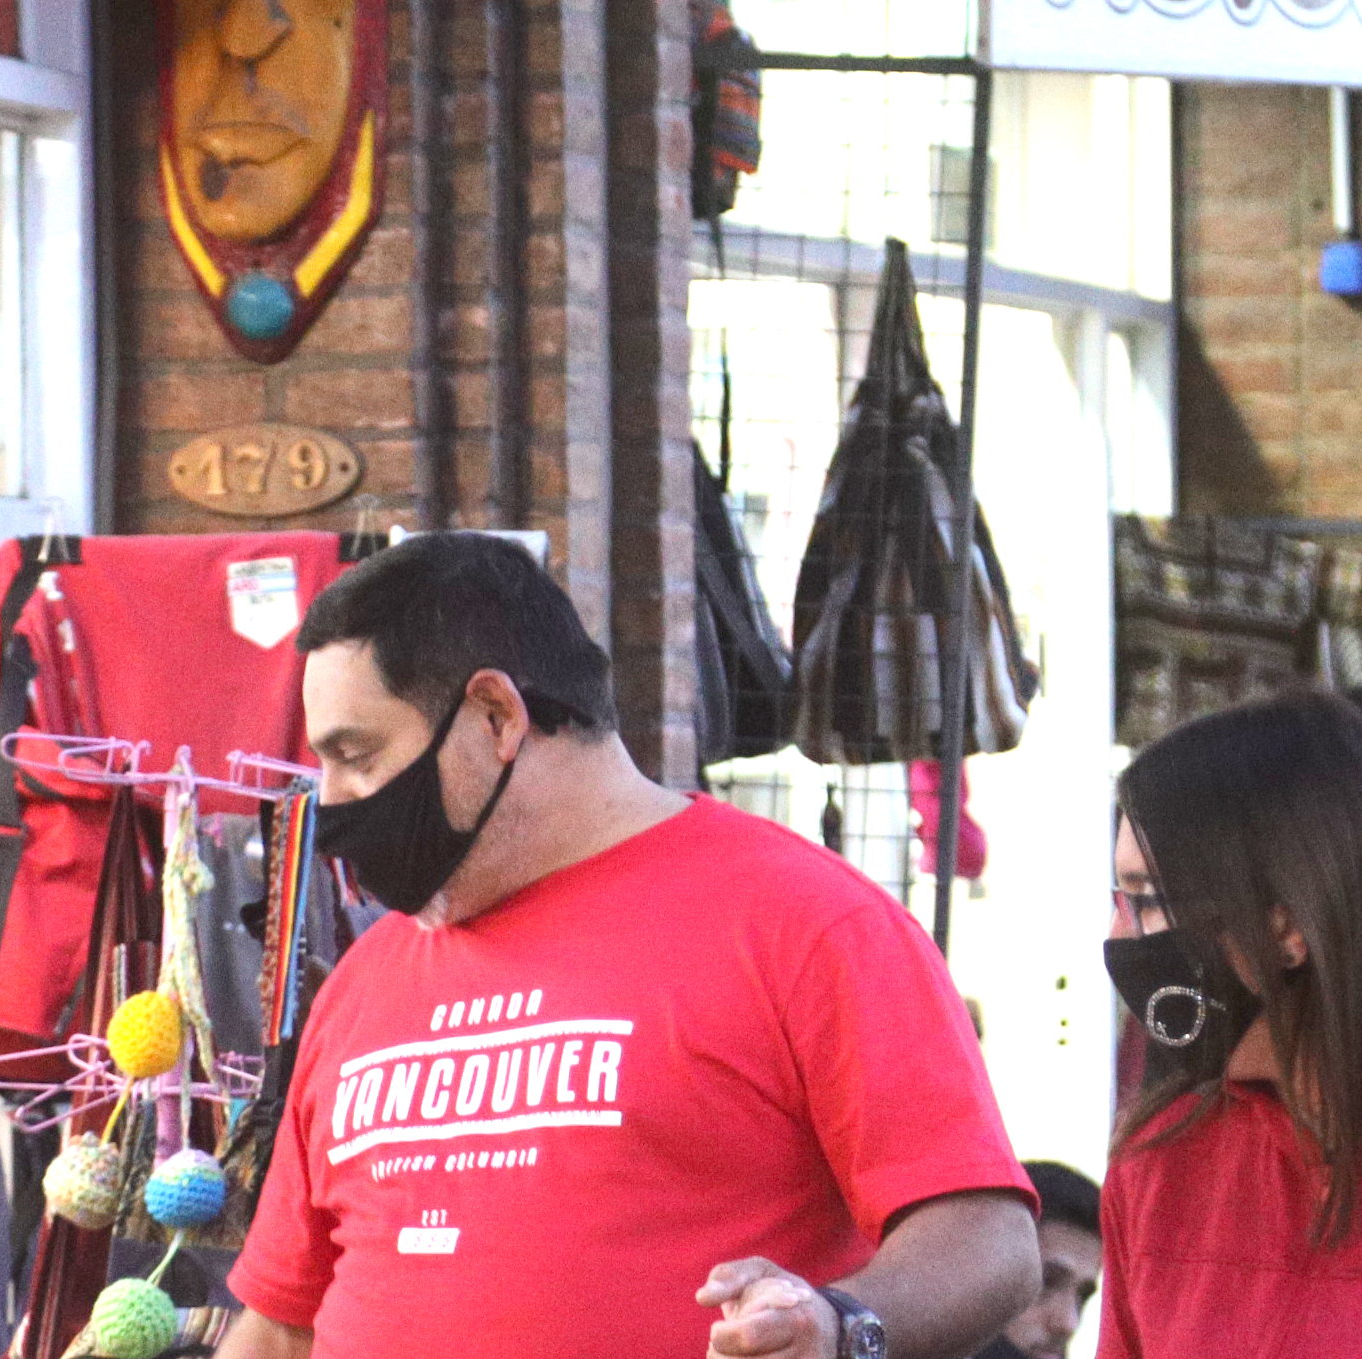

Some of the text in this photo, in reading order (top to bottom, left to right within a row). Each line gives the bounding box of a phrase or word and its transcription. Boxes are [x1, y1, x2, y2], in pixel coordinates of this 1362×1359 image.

[196, 438, 331, 496] 179
[430, 988, 543, 1031] CANADA
[331, 1039, 623, 1140] VANCOUVER
